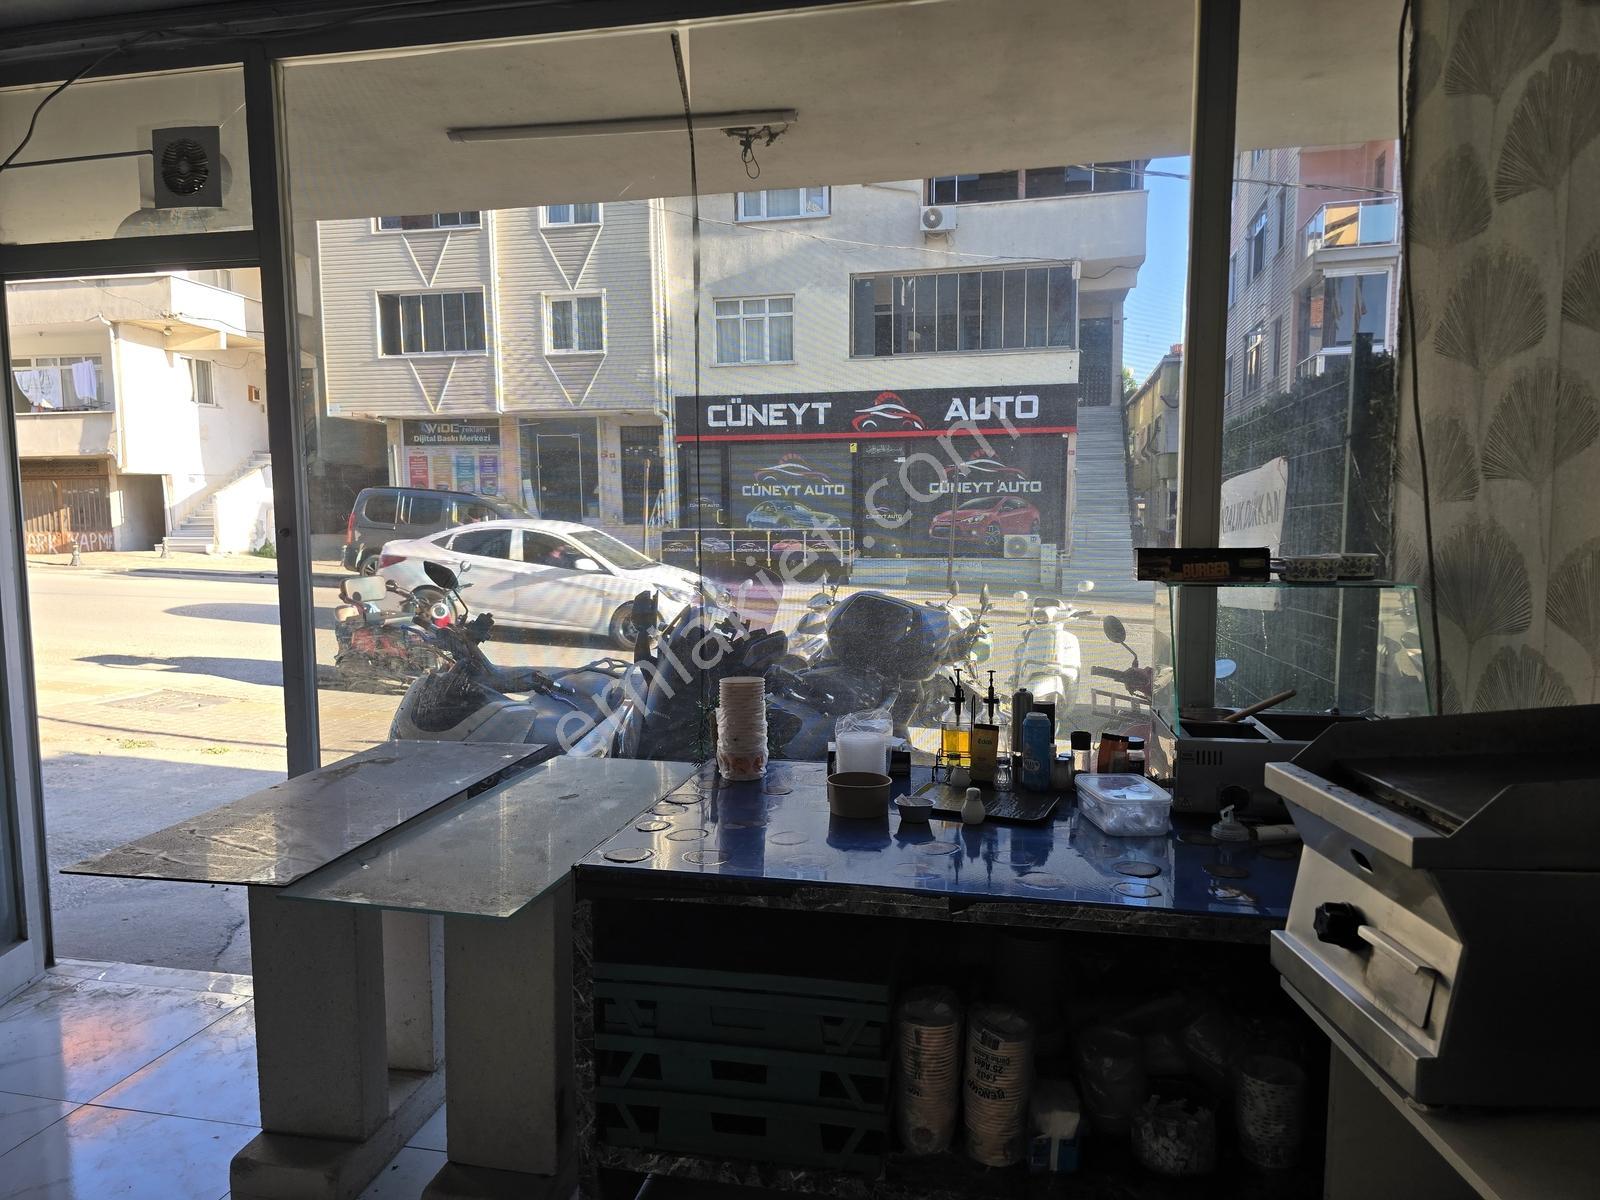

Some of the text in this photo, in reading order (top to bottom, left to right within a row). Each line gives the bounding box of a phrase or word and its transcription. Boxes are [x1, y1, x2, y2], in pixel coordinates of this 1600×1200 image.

[707, 395, 1039, 427] CÜNEYT AUTO
[413, 434, 491, 444] Dijital Baskı Merkezi
[742, 483, 846, 496] CÜNEYT AUTO
[929, 480, 1043, 494] CÜNEYT AUTO
[26, 532, 58, 554] ARK
[1182, 560, 1231, 578] BURGER
